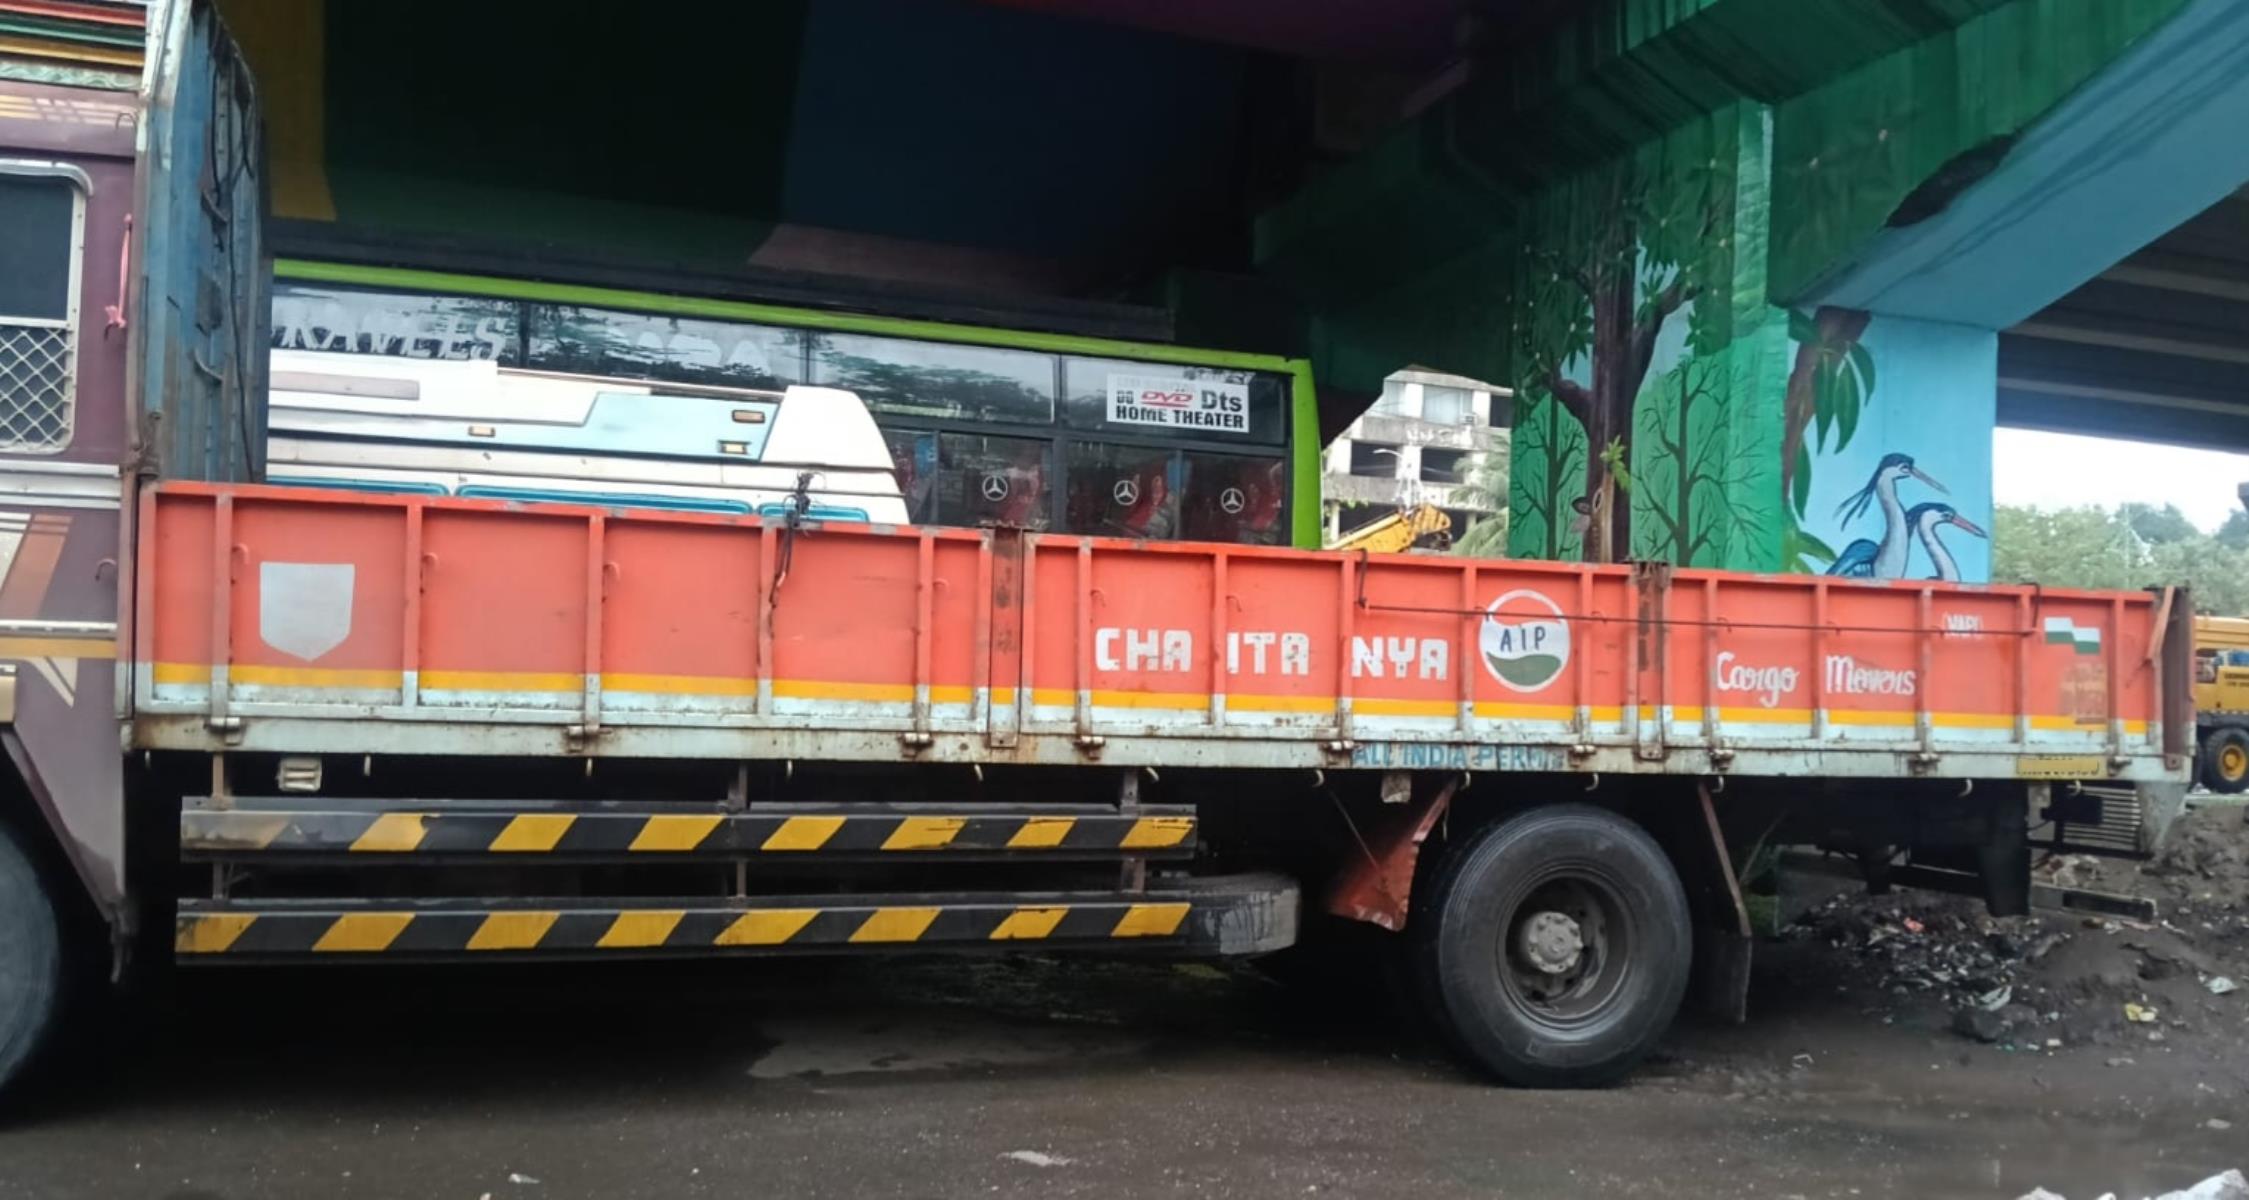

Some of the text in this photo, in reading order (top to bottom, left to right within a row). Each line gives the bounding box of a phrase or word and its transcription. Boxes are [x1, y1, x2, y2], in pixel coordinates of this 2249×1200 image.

[1141, 390, 1193, 403] DVD
[1201, 389, 1242, 412] Dts
[1116, 405, 1243, 428] HOME THEATER
[1500, 627, 1546, 652] AIP
[1353, 742, 1391, 767] ALL
[1403, 744, 1466, 768] INDIA
